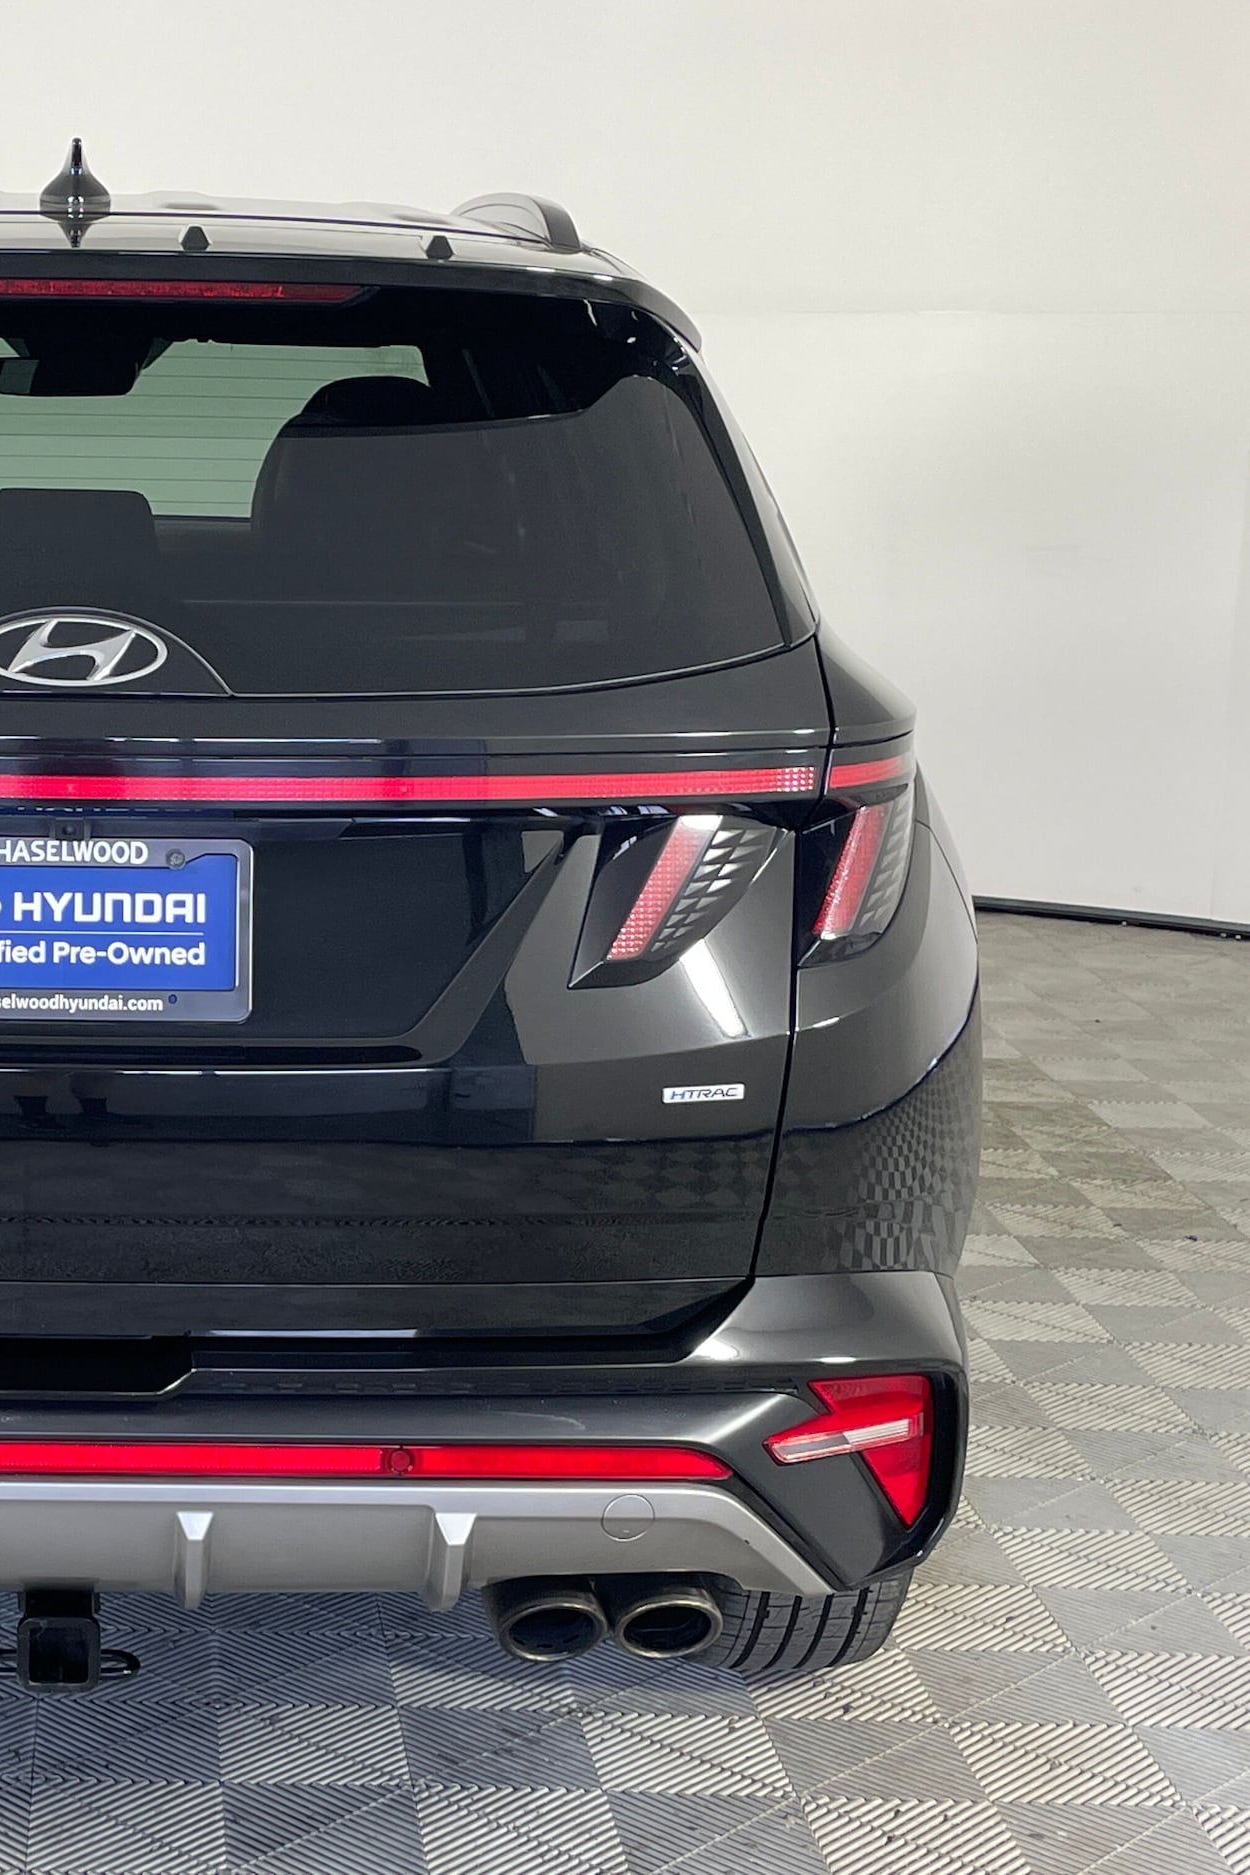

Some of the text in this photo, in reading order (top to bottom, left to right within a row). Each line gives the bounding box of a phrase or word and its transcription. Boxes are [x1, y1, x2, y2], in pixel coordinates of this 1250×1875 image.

[13, 891, 206, 924] HYUNDAI
[52, 941, 206, 966] Pre-Owned
[669, 1086, 739, 1101] HTRAC
